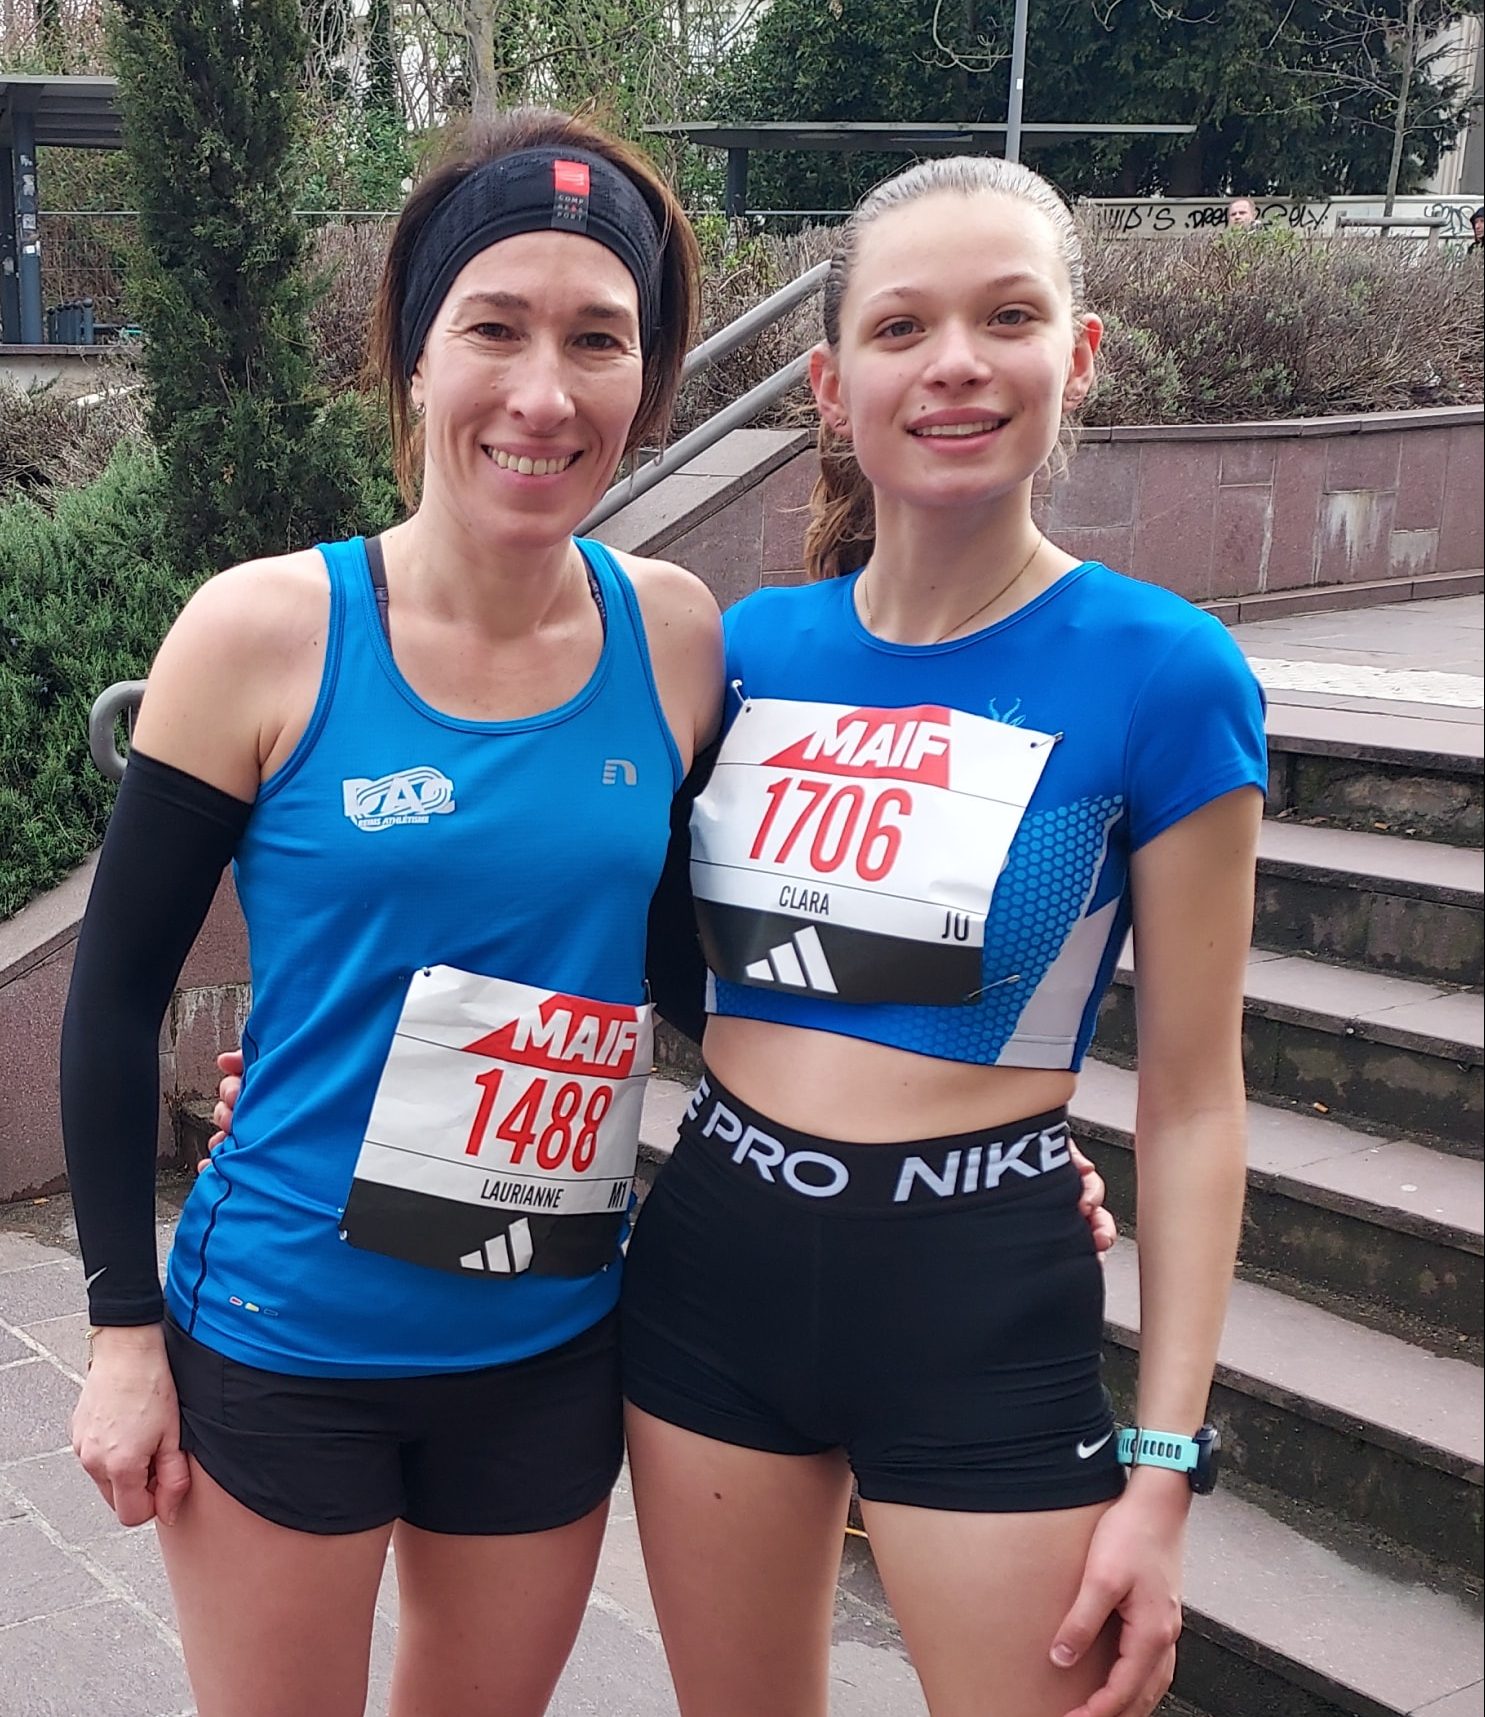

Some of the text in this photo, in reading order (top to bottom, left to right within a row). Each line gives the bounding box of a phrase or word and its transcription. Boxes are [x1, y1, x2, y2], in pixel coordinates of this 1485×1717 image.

[802, 720, 951, 770] MAIF
[749, 777, 912, 882] 1706
[778, 885, 830, 915] CLARA
[941, 911, 971, 942] JU
[511, 1008, 638, 1067] MAIF
[465, 1068, 614, 1173] 1488
[702, 1101, 850, 1198] PRO
[893, 1121, 1072, 1202] NIKE
[480, 1178, 565, 1209] LAURIANNE
[607, 1181, 629, 1210] M1
